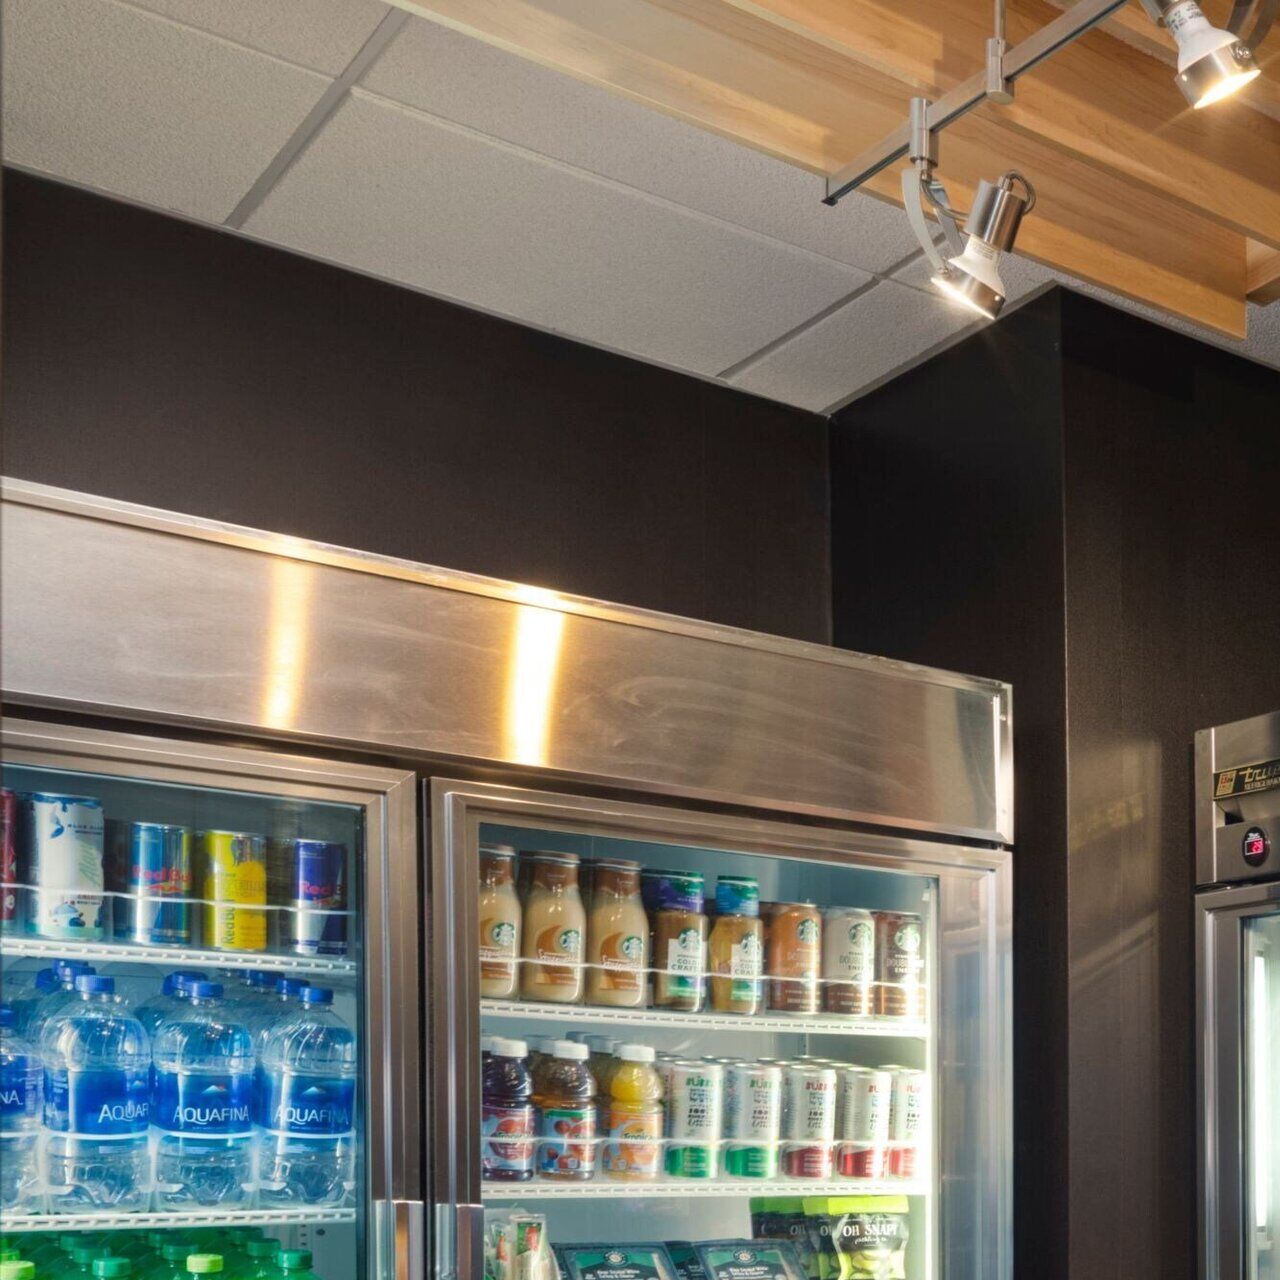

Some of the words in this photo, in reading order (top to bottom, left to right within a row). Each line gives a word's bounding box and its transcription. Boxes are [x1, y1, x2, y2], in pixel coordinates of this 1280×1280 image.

[98, 1104, 149, 1123] AQUAF
[173, 1104, 249, 1123] AQUAFINA
[274, 1104, 349, 1126] AQUAFINA
